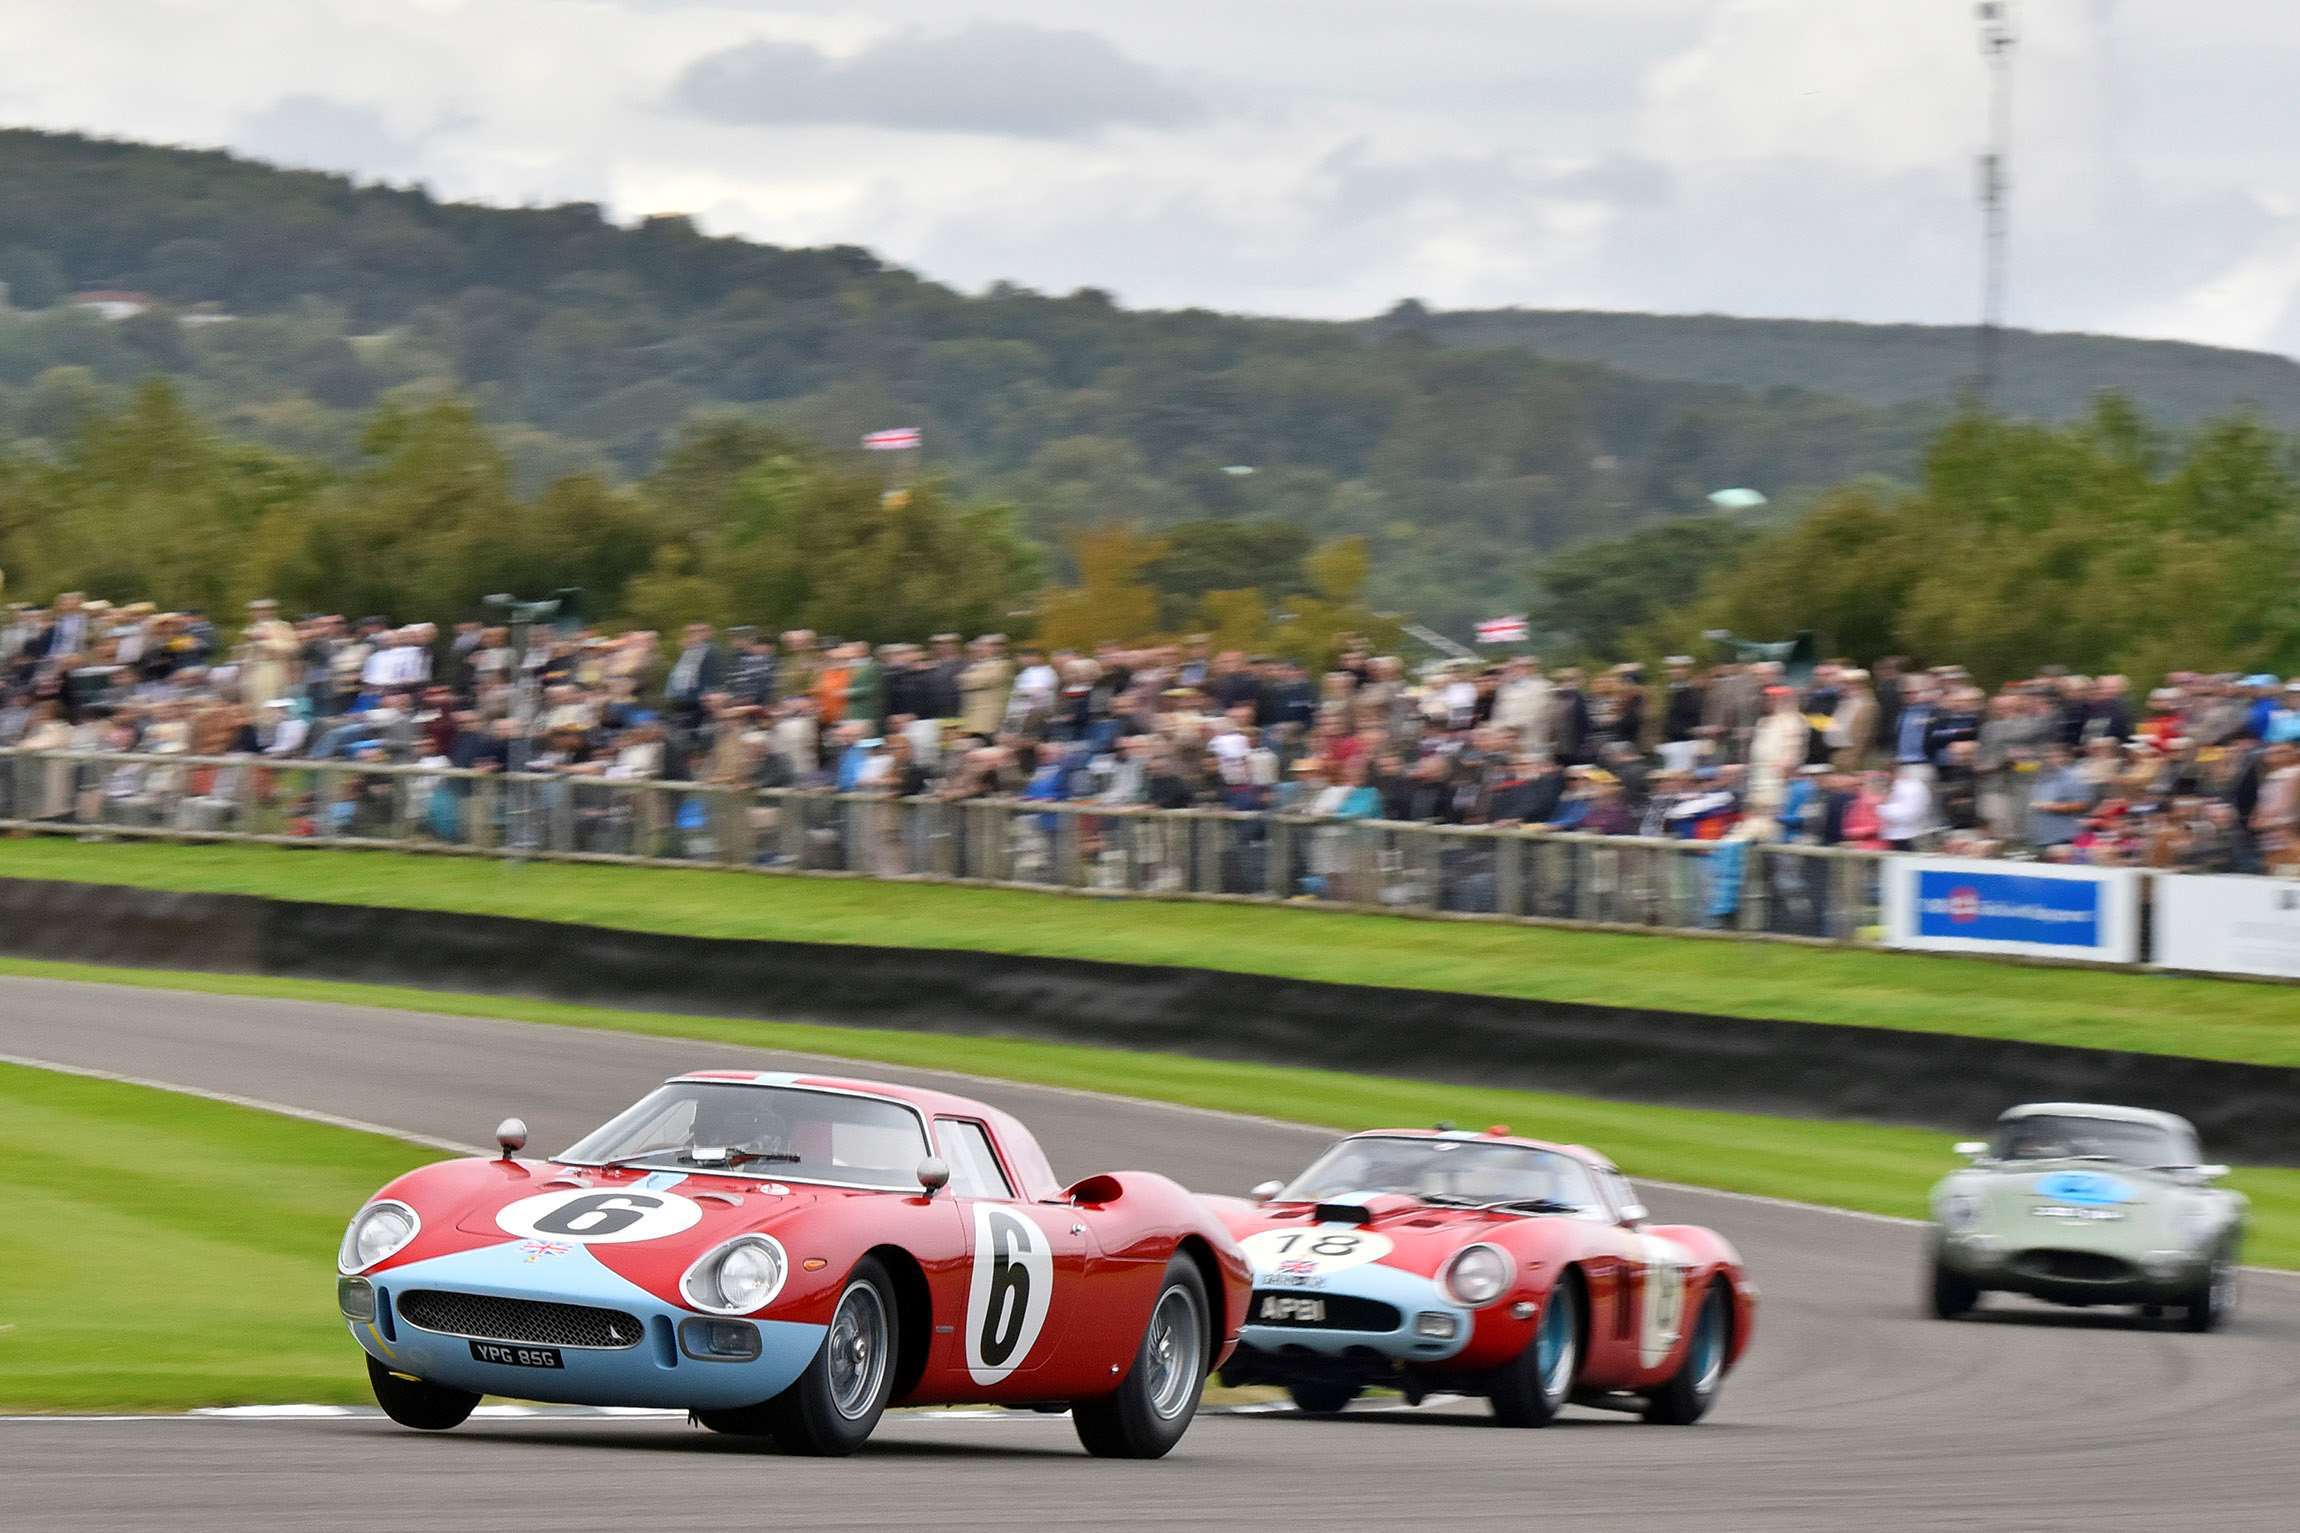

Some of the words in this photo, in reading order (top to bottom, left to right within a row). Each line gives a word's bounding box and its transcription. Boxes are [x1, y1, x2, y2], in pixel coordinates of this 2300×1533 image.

[532, 1193, 664, 1236] 6
[1276, 1234, 1361, 1256] 18
[980, 1211, 1032, 1367] 6
[477, 1344, 513, 1363] YPG
[517, 1350, 555, 1366] 85G
